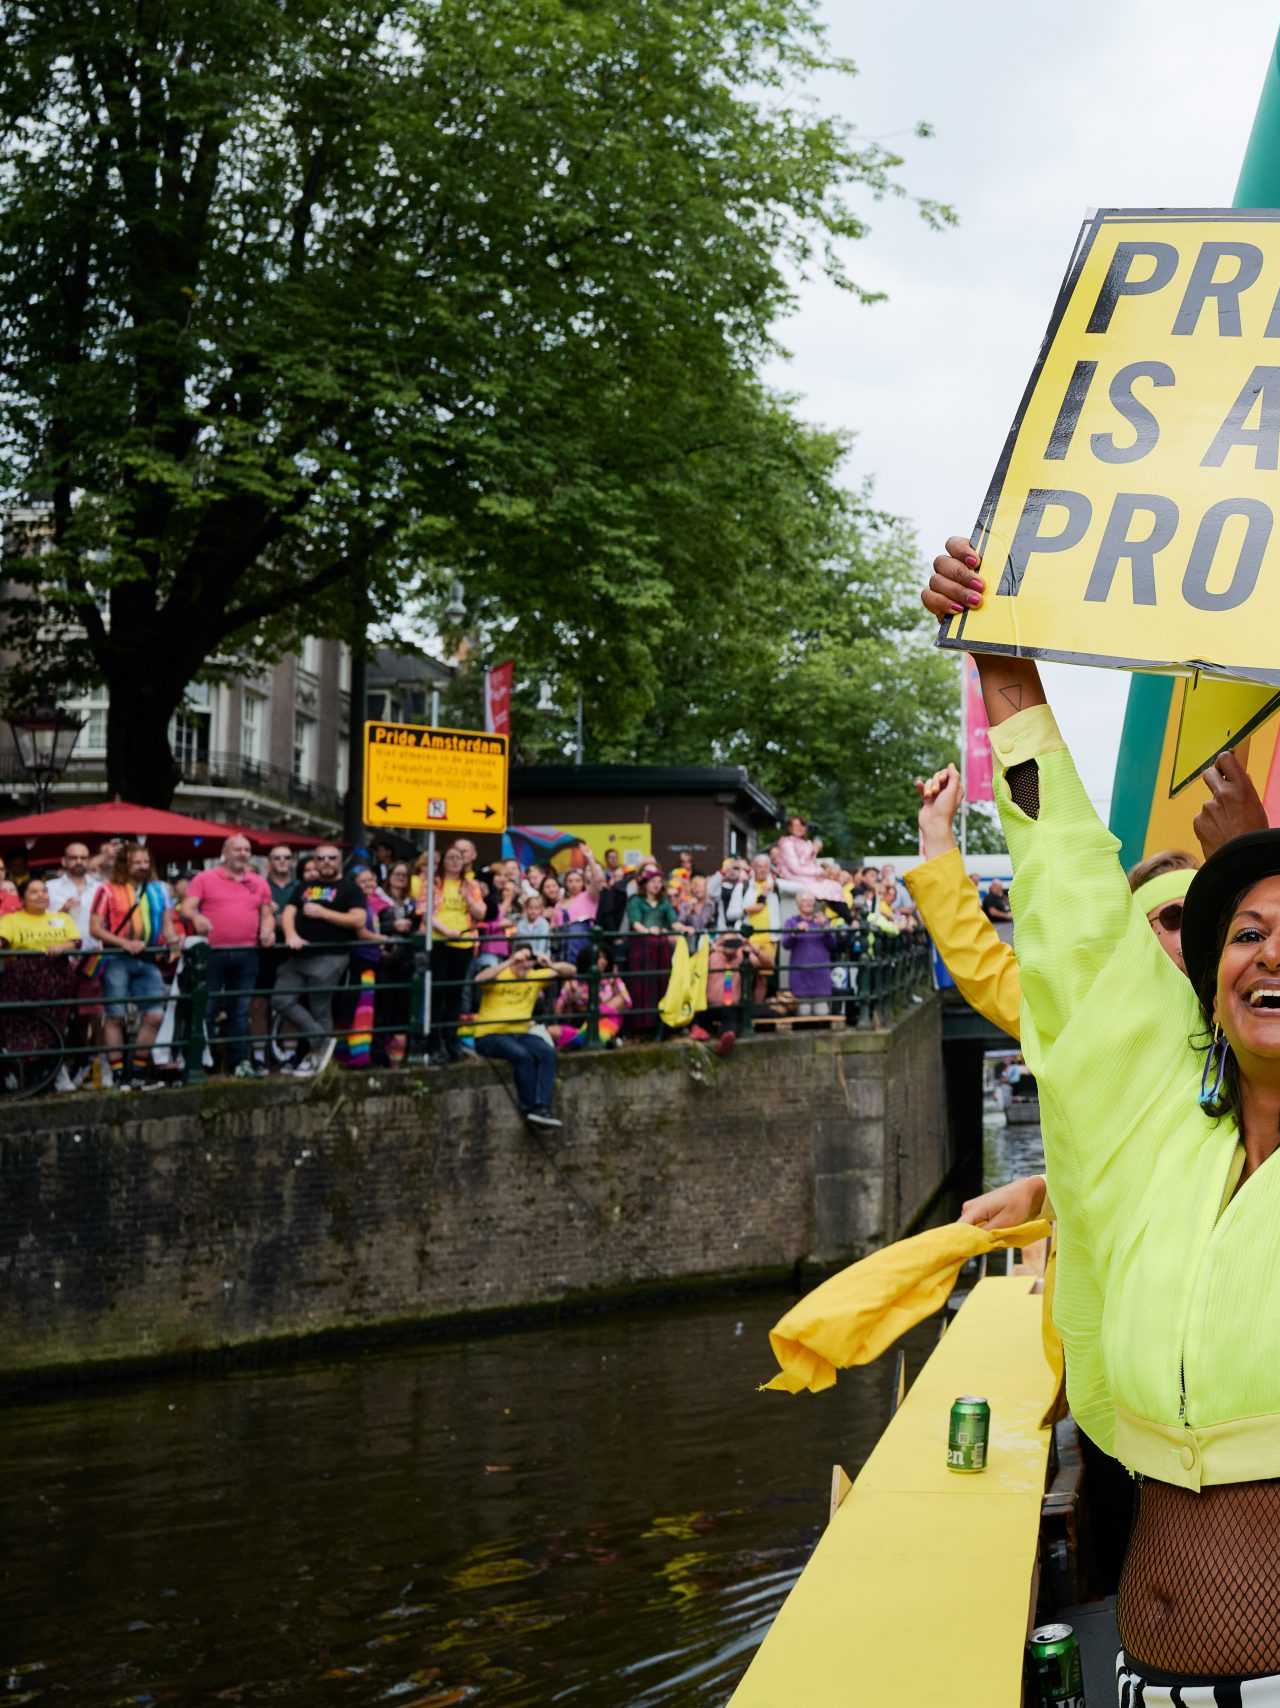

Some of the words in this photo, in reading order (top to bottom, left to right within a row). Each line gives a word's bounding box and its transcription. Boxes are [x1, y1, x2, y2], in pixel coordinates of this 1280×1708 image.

[1043, 360, 1176, 464] IS
[375, 727, 416, 748] Pride
[420, 732, 502, 755] Amsterdam
